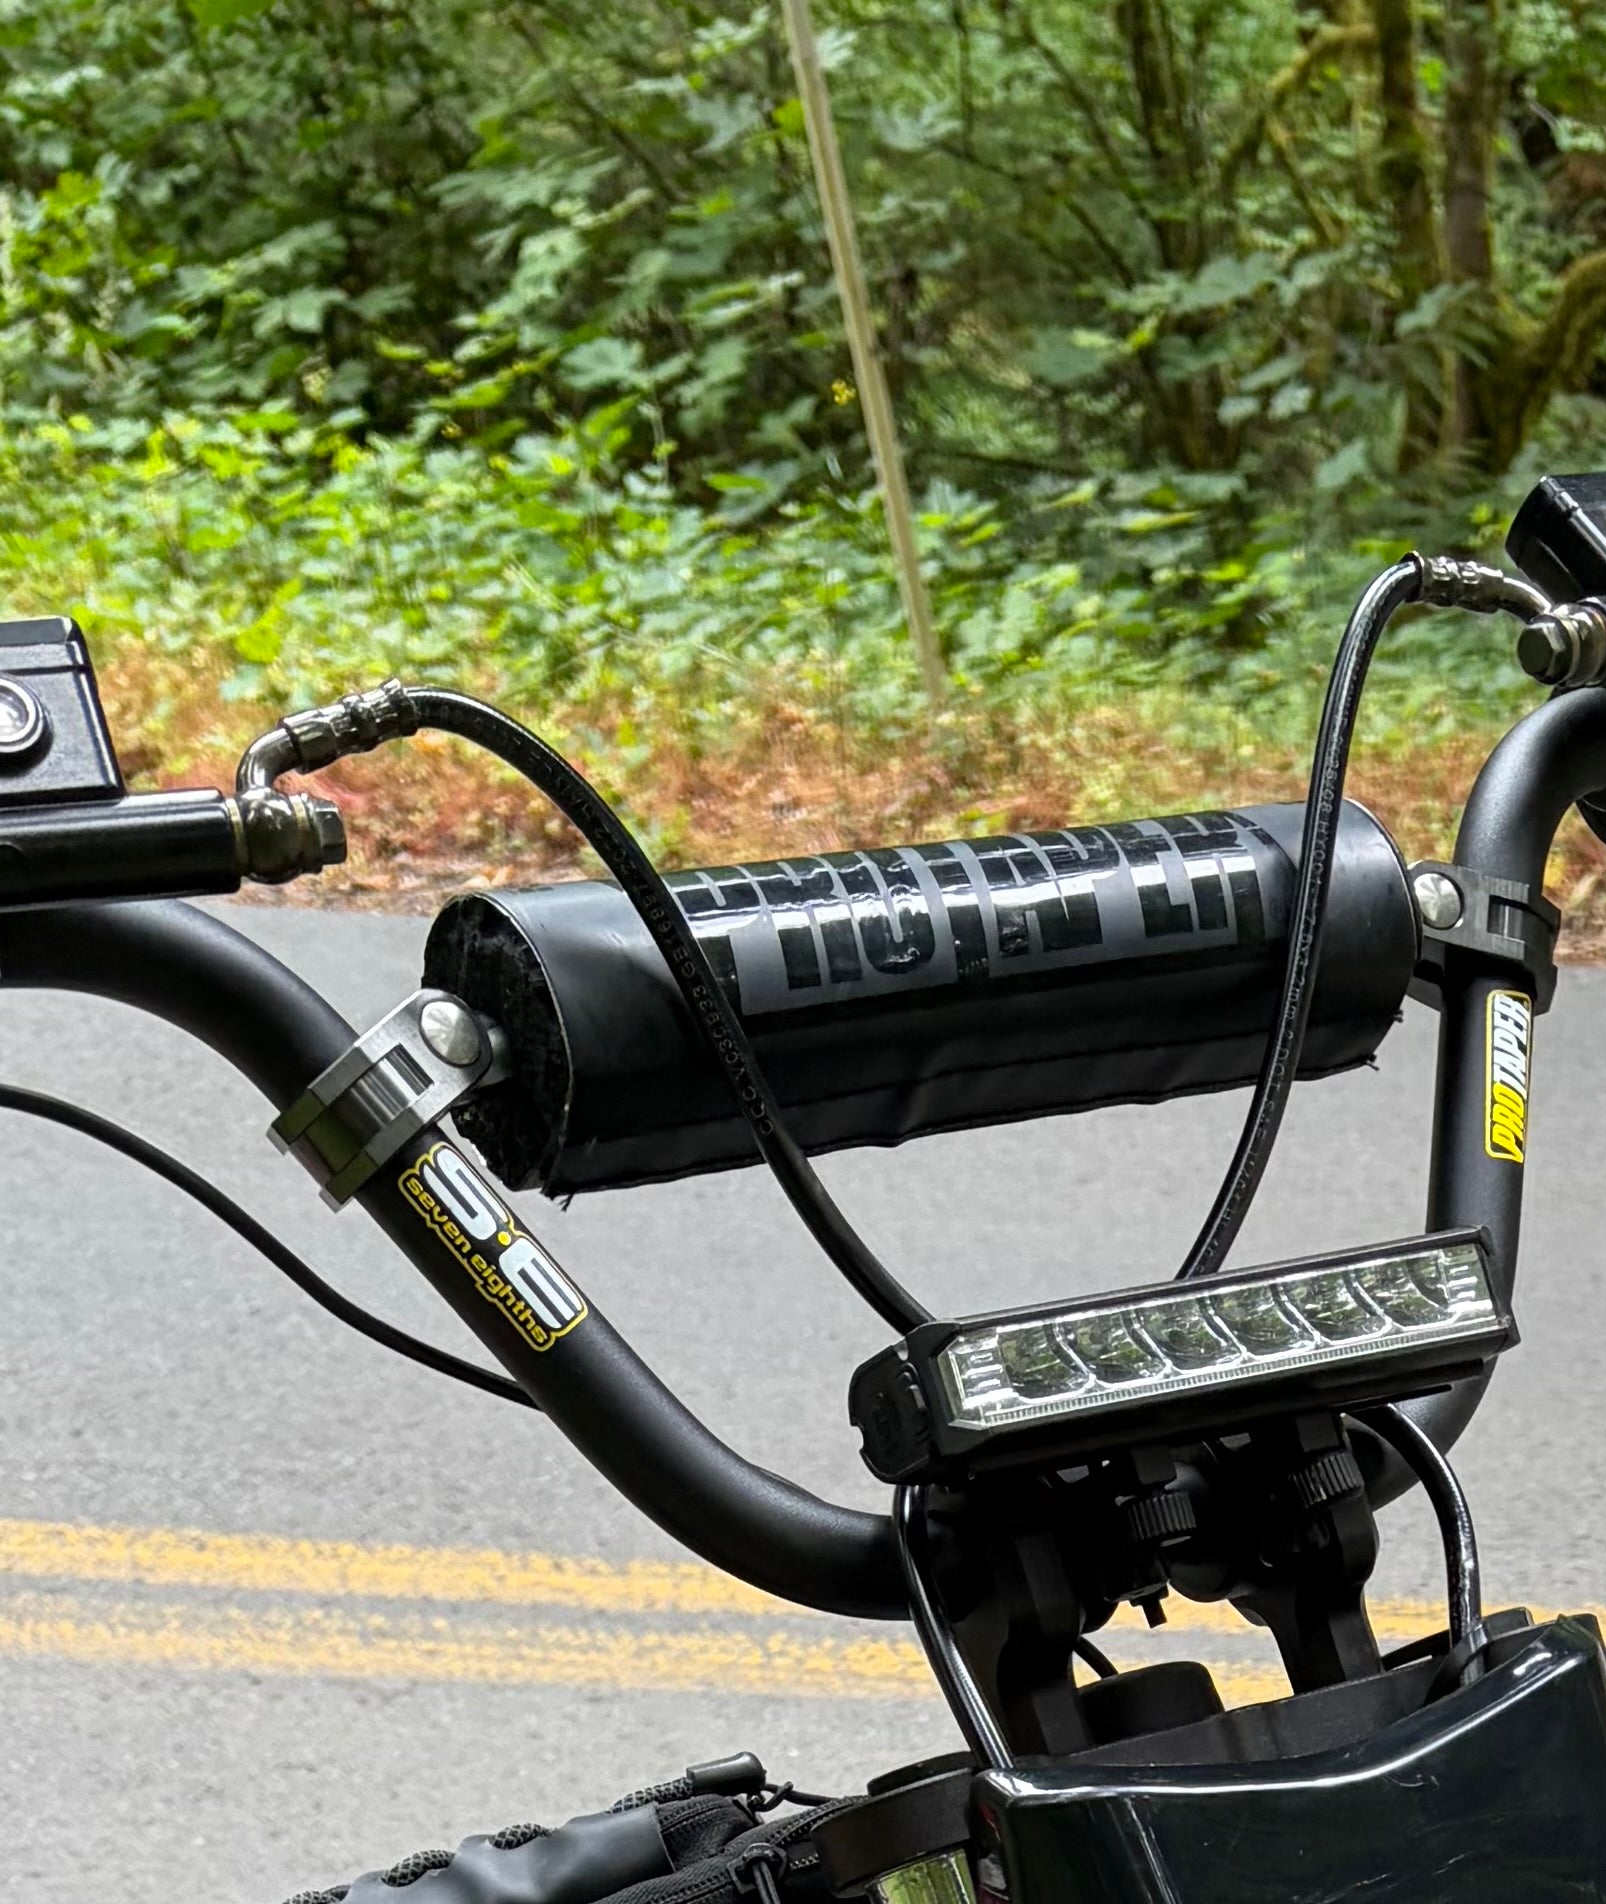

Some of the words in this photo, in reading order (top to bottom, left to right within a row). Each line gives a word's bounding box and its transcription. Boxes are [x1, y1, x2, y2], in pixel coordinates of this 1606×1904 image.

[1492, 993, 1530, 1163] PROTAPER
[405, 1176, 472, 1253] seven
[470, 1253, 548, 1344] eighths
